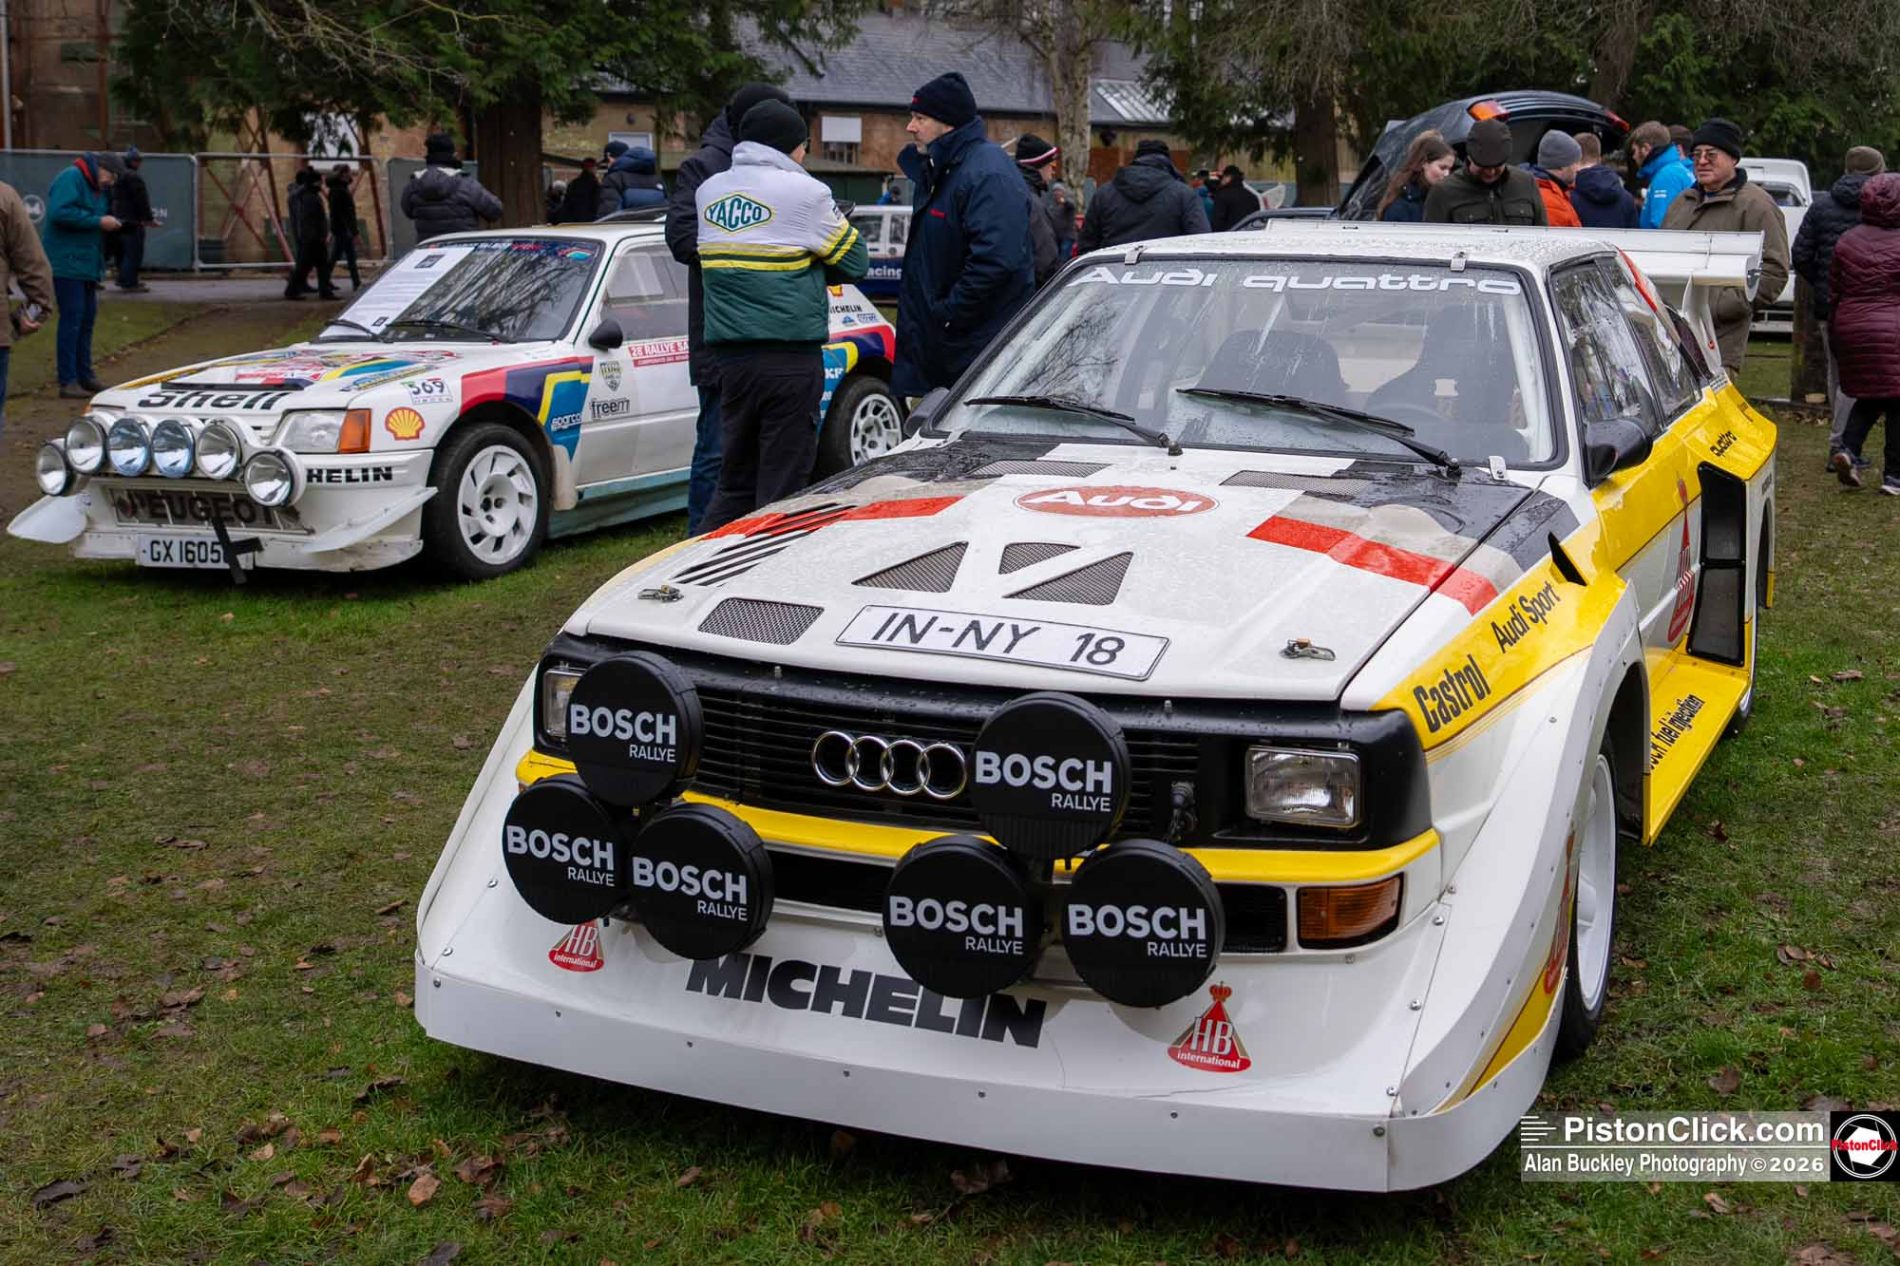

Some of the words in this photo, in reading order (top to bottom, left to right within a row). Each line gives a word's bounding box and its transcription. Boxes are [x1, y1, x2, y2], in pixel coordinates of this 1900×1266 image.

[708, 197, 763, 229] YACCO
[1067, 267, 1218, 287] Audi
[1242, 272, 1522, 294] quattro
[644, 342, 676, 355] RALLYE
[137, 389, 292, 411] Shell
[408, 380, 445, 395] 569
[306, 466, 393, 483] HELIN
[1024, 489, 1203, 512] Audi
[150, 540, 174, 562] GX
[1490, 603, 1531, 654] Audi
[1518, 580, 1561, 625] Sport
[870, 612, 1042, 654] IN-NY
[1068, 632, 1126, 666] 18
[1413, 653, 1492, 733] Castrol
[570, 703, 677, 746] BOSCH
[1651, 718, 1682, 748] fuel
[628, 744, 677, 763] RALLYE
[974, 750, 1113, 794] BOSCH
[1050, 793, 1112, 812] RALLYE
[506, 824, 615, 871] BOSCH
[566, 865, 616, 887] RALLYE
[632, 856, 748, 905] BOSCH
[696, 900, 748, 922] RALLYE
[888, 895, 1024, 938] BOSCH
[1066, 903, 1207, 940] BOSCH
[564, 925, 599, 957] HB
[964, 936, 1024, 955] RALLYE
[1146, 941, 1208, 958] RALLYE
[685, 952, 1048, 1049] MICHELIN
[1190, 1016, 1234, 1056] HB
[1177, 1050, 1241, 1069] international
